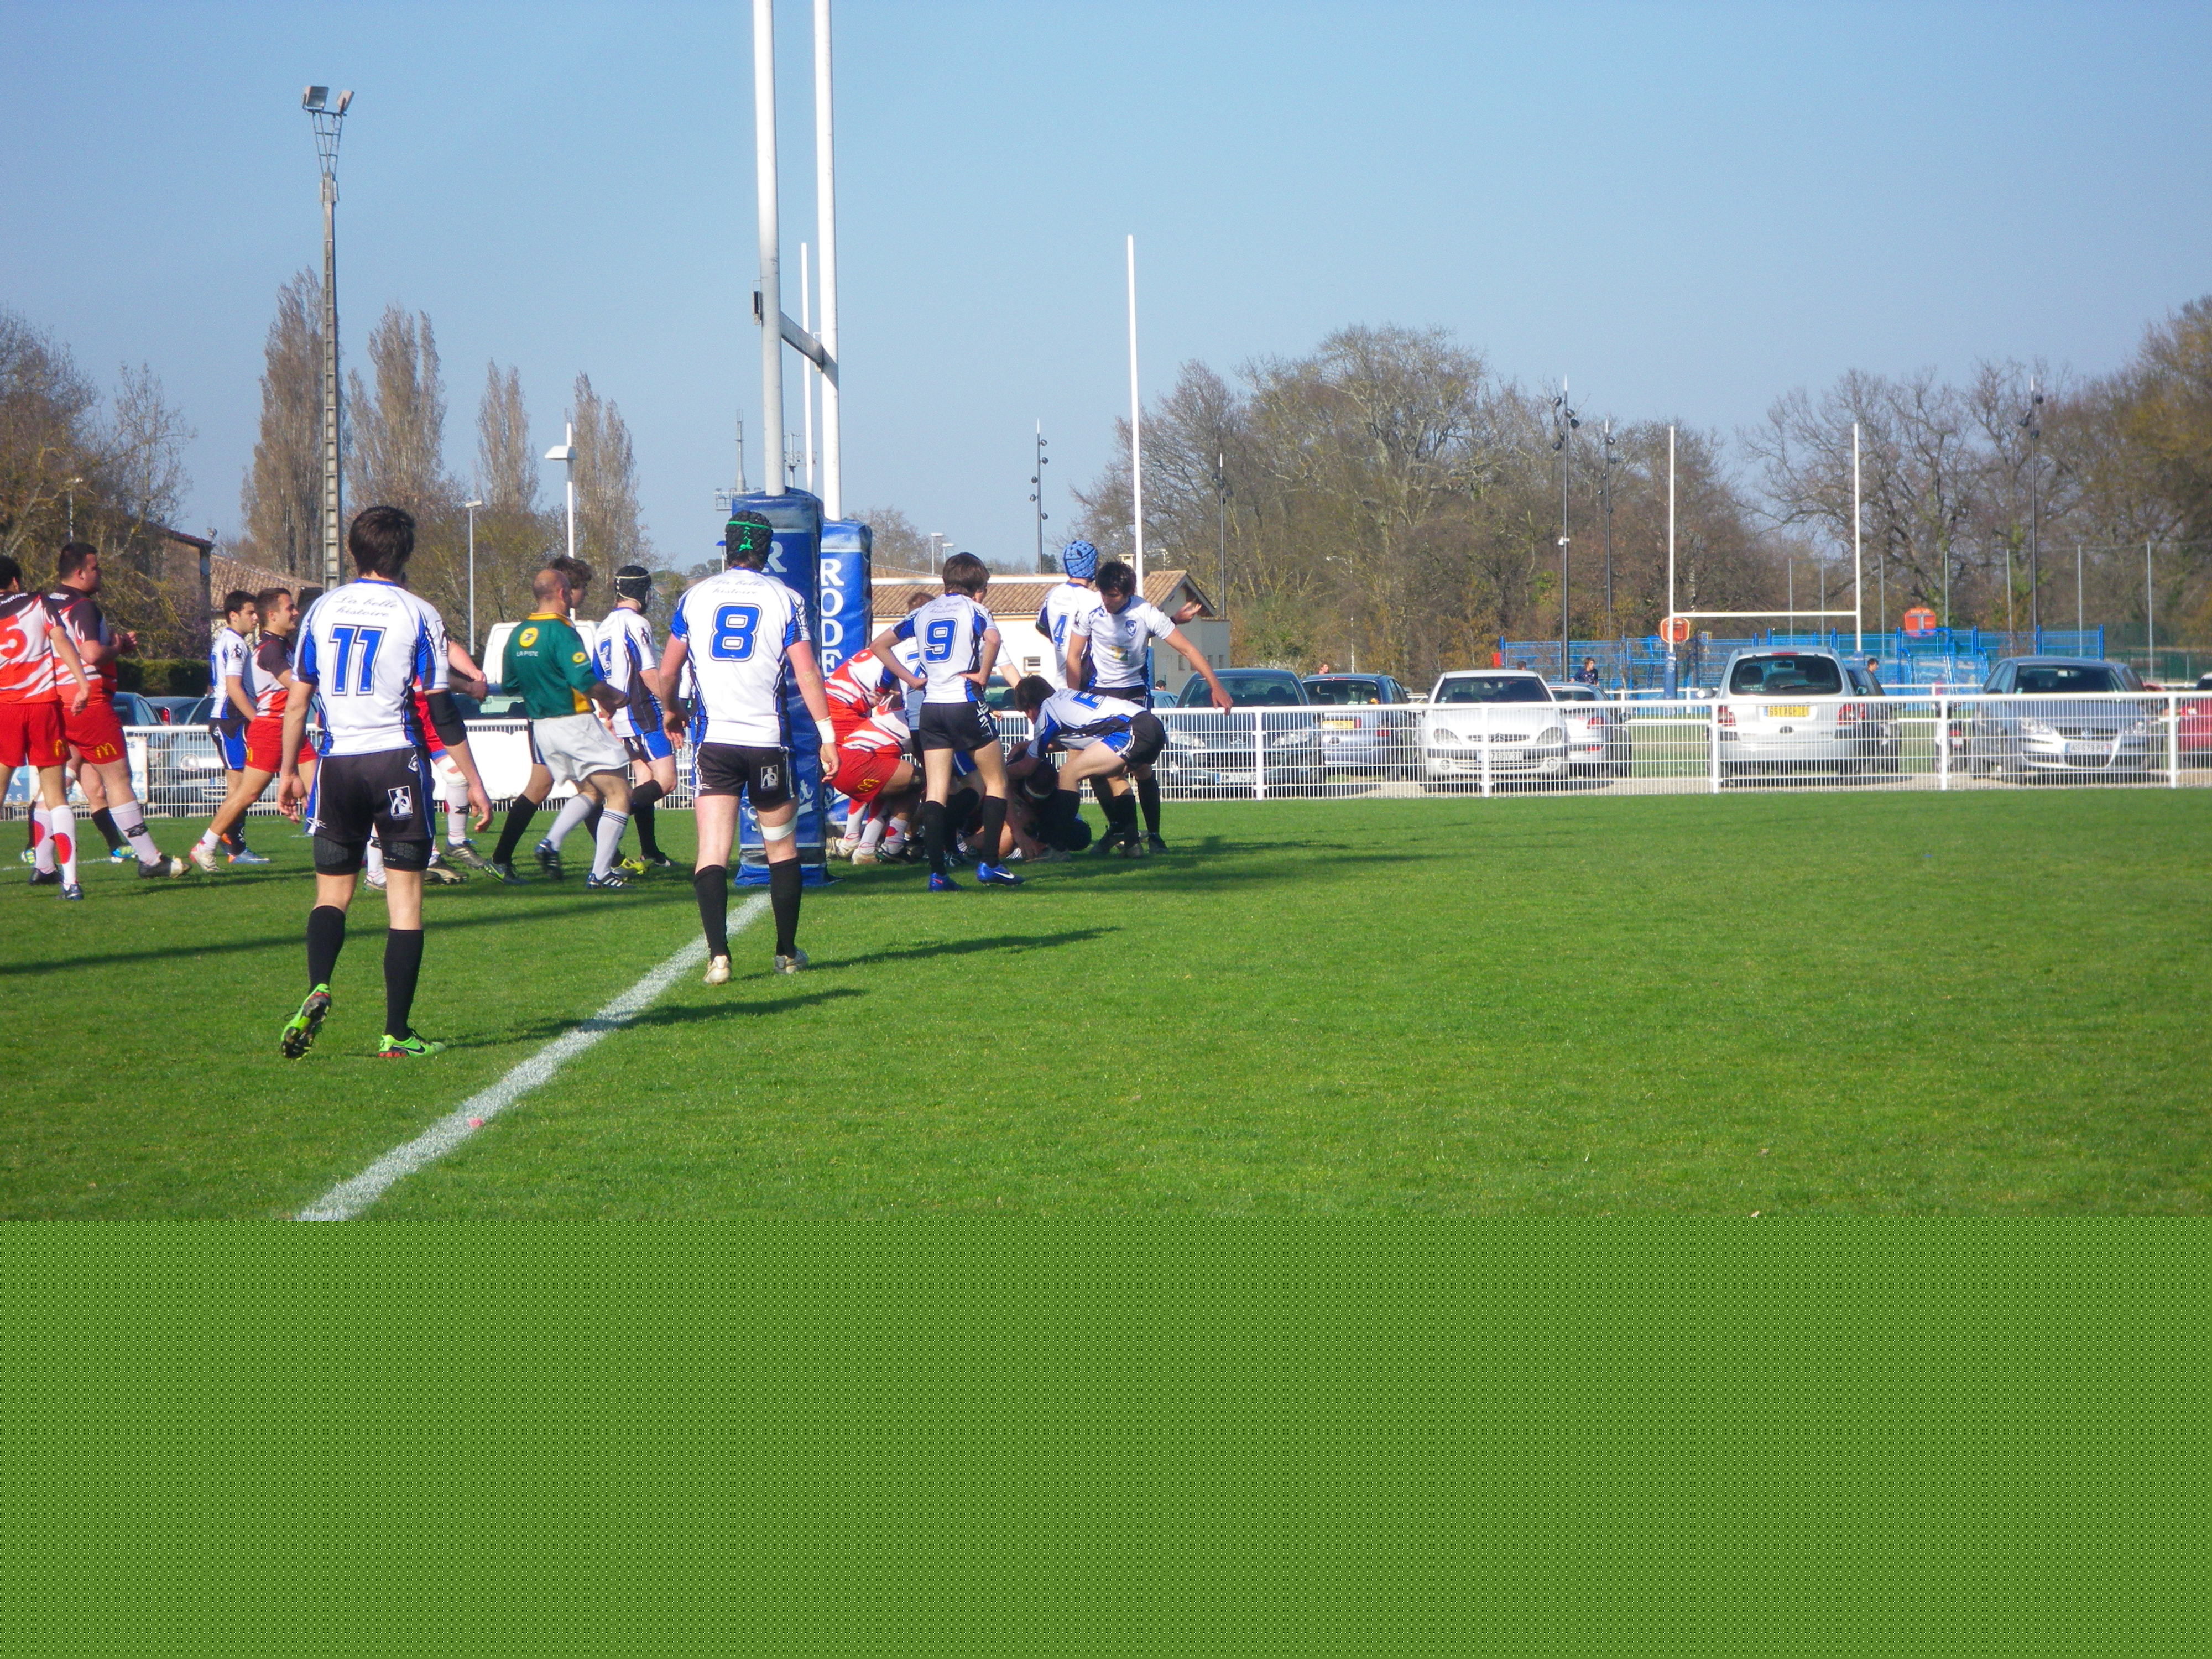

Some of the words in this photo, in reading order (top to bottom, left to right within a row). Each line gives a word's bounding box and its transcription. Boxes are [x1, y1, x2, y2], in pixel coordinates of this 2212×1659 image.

[333, 593, 357, 604] La
[362, 598, 398, 609] belle
[336, 606, 390, 618] histoire
[709, 602, 763, 662] 8
[924, 617, 958, 664] 9
[1052, 612, 1070, 652] 4
[329, 623, 387, 696] 11
